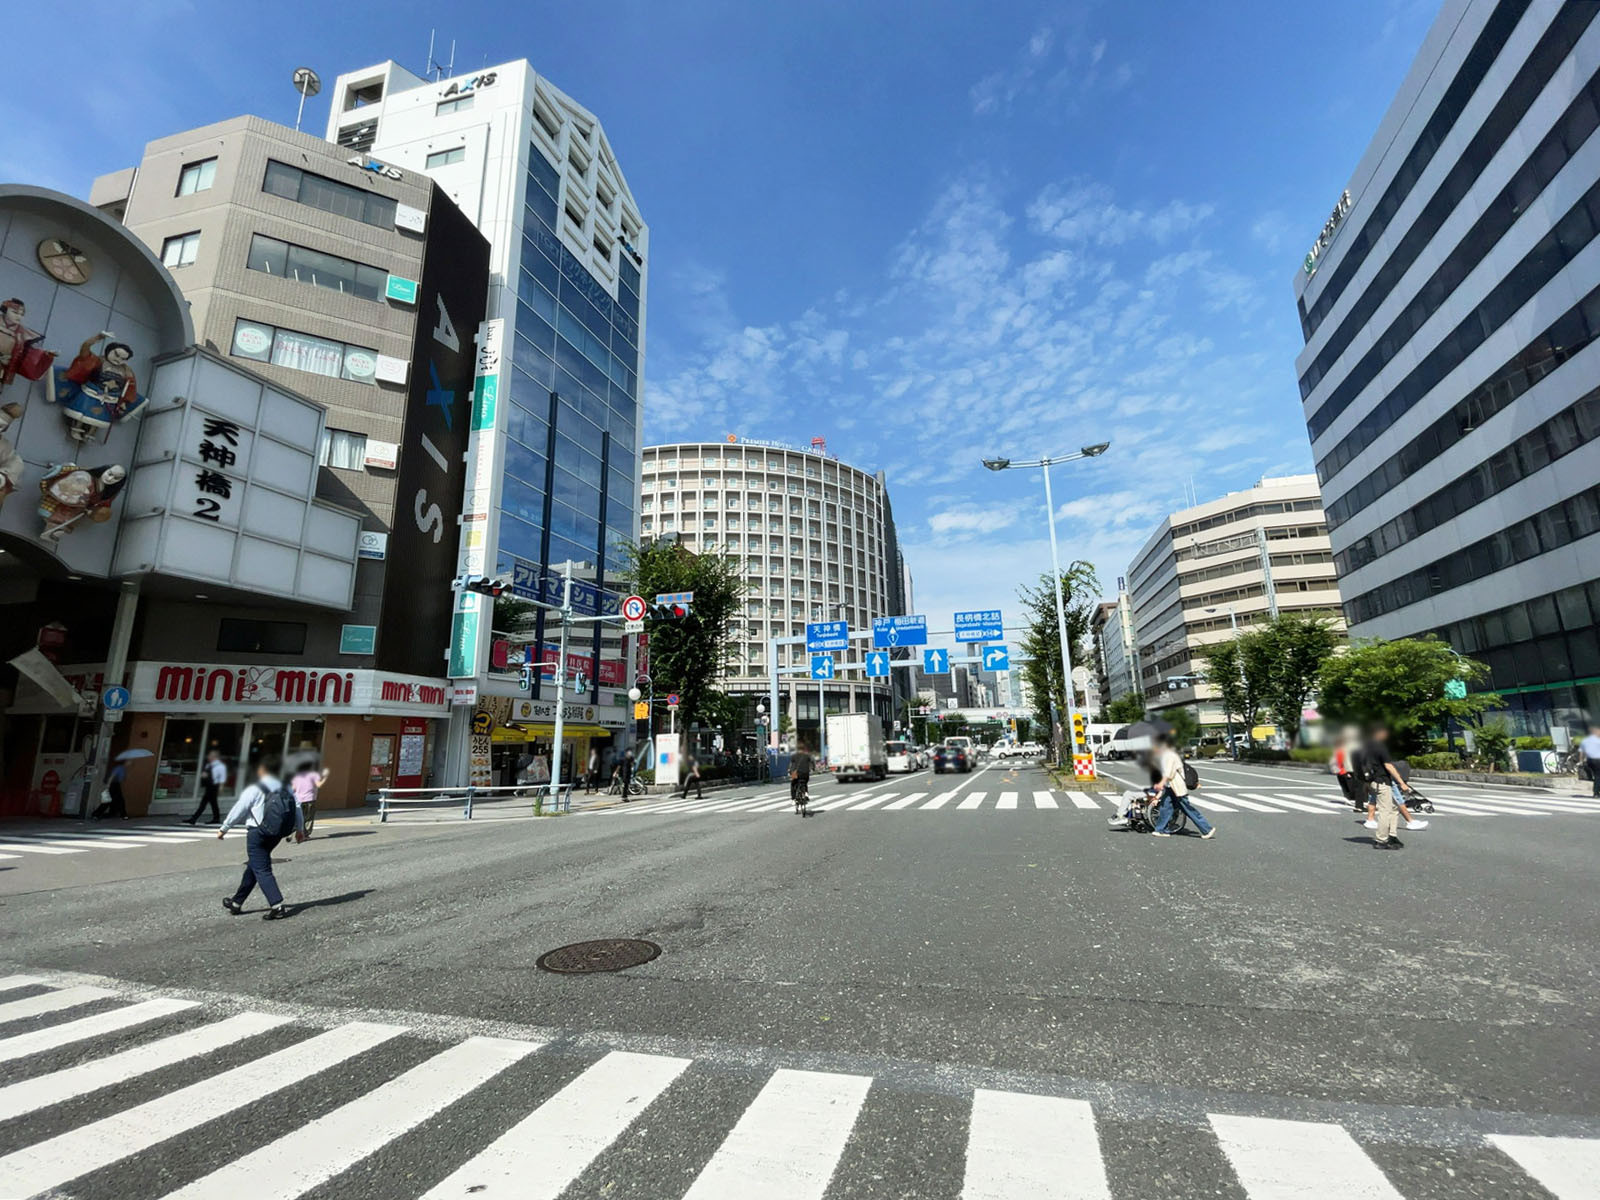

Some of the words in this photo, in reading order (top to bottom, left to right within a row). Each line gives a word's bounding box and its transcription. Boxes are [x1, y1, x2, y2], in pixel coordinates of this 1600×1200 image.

[443, 72, 498, 98] AXIS
[346, 156, 404, 180] AXIS
[486, 326, 496, 341] bar
[415, 292, 460, 544] AXIS
[193, 418, 241, 522] 天神橋2
[813, 623, 841, 633] 天神橋
[155, 666, 245, 701] mini
[276, 670, 354, 703] mini
[381, 681, 411, 702] mini
[420, 685, 445, 704] mini
[472, 736, 489, 746] うどん
[472, 745, 489, 754] 255
